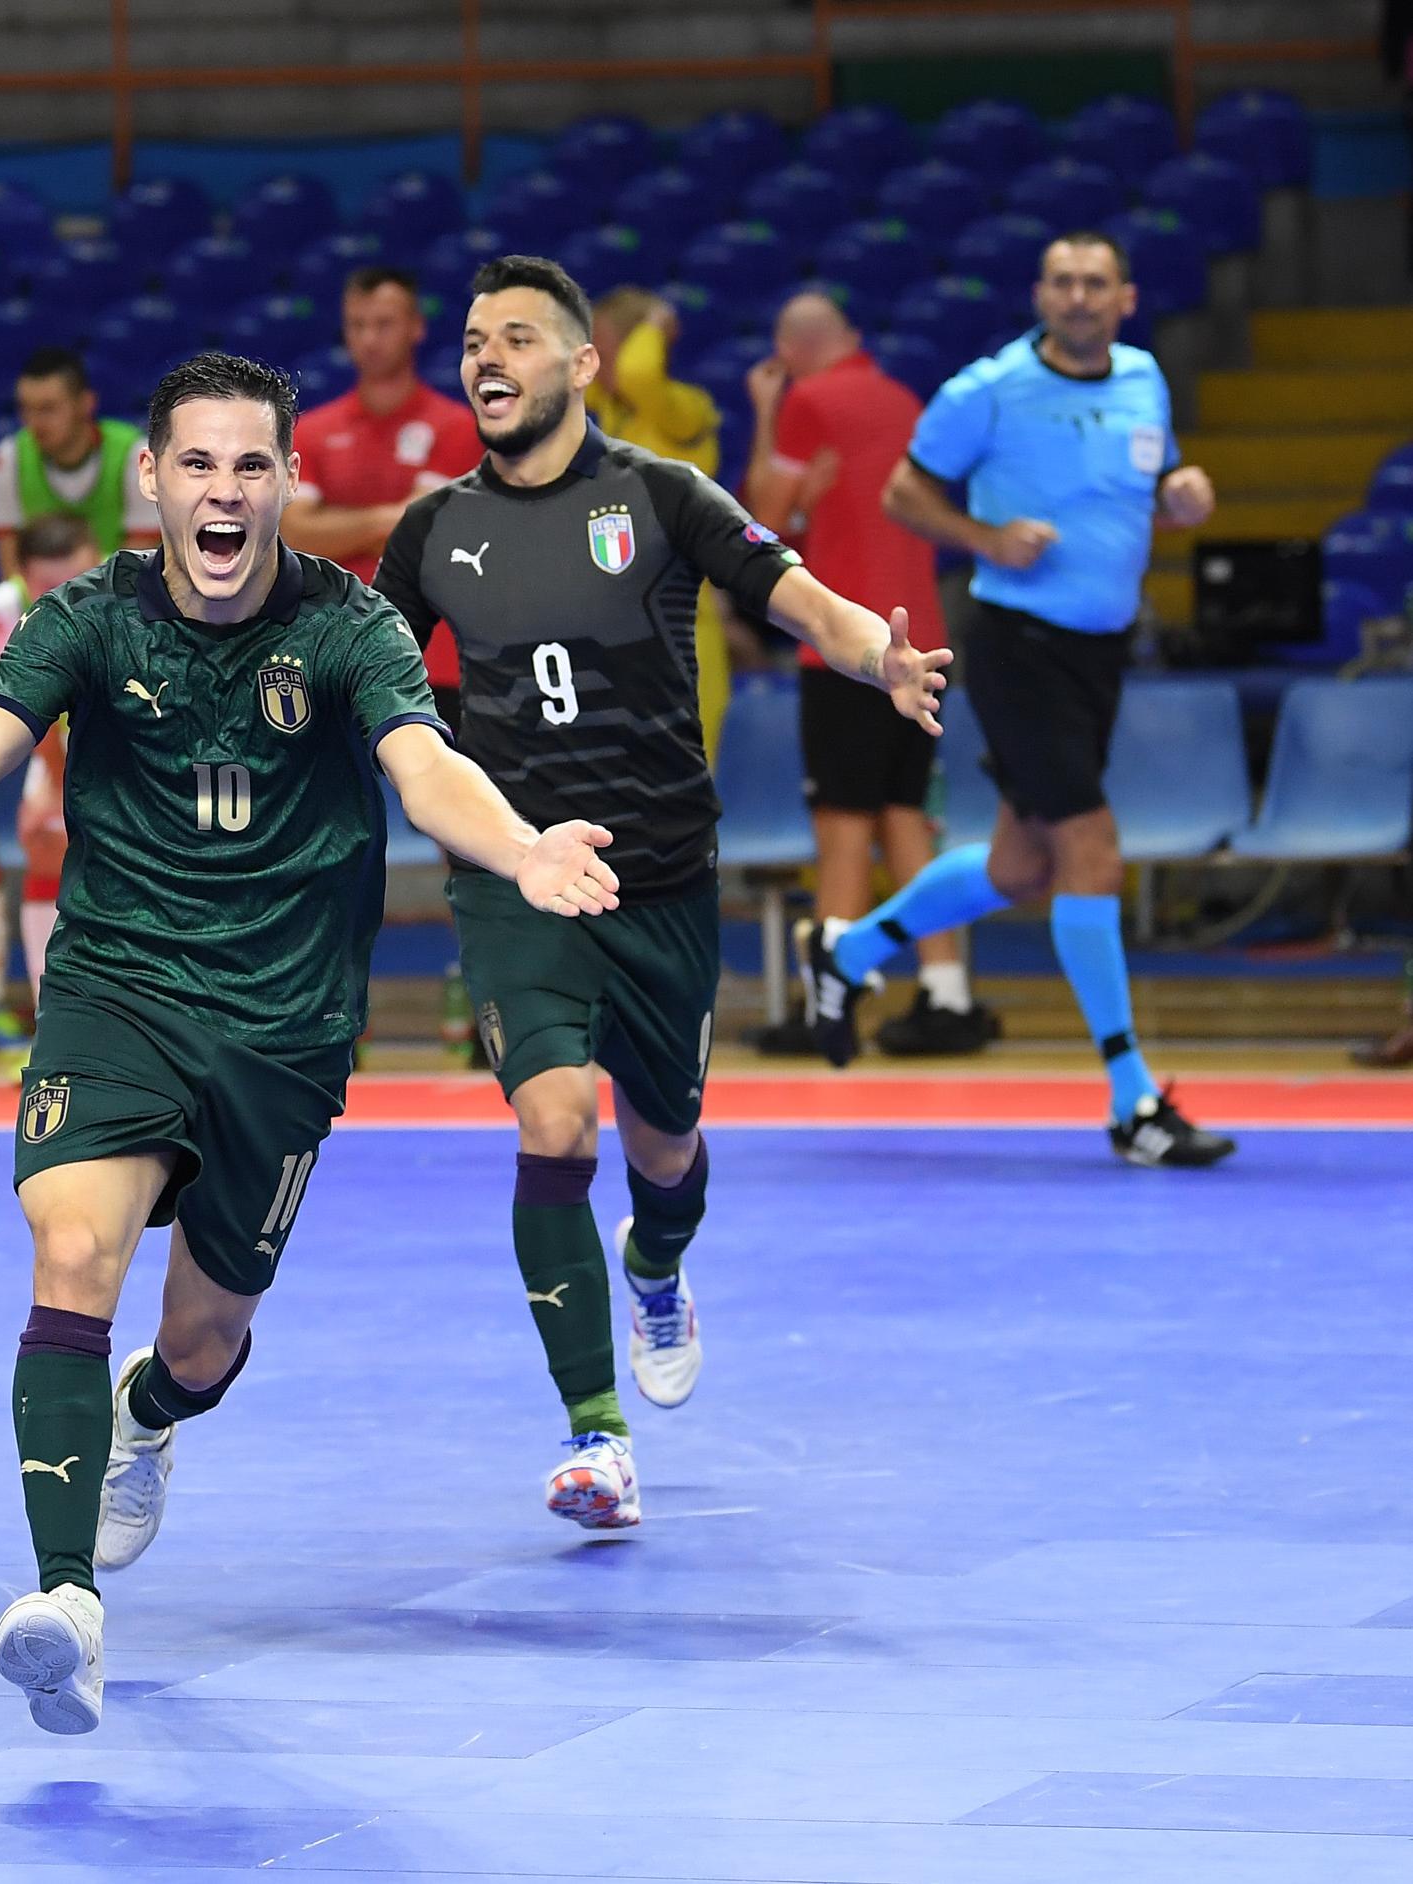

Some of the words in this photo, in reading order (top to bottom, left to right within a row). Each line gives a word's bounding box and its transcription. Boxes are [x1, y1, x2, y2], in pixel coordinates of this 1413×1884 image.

[262, 671, 302, 685] ITALIA
[531, 642, 579, 726] 9
[192, 763, 251, 832] 10
[28, 1089, 66, 1107] ITALIA
[260, 1150, 314, 1234] 10
